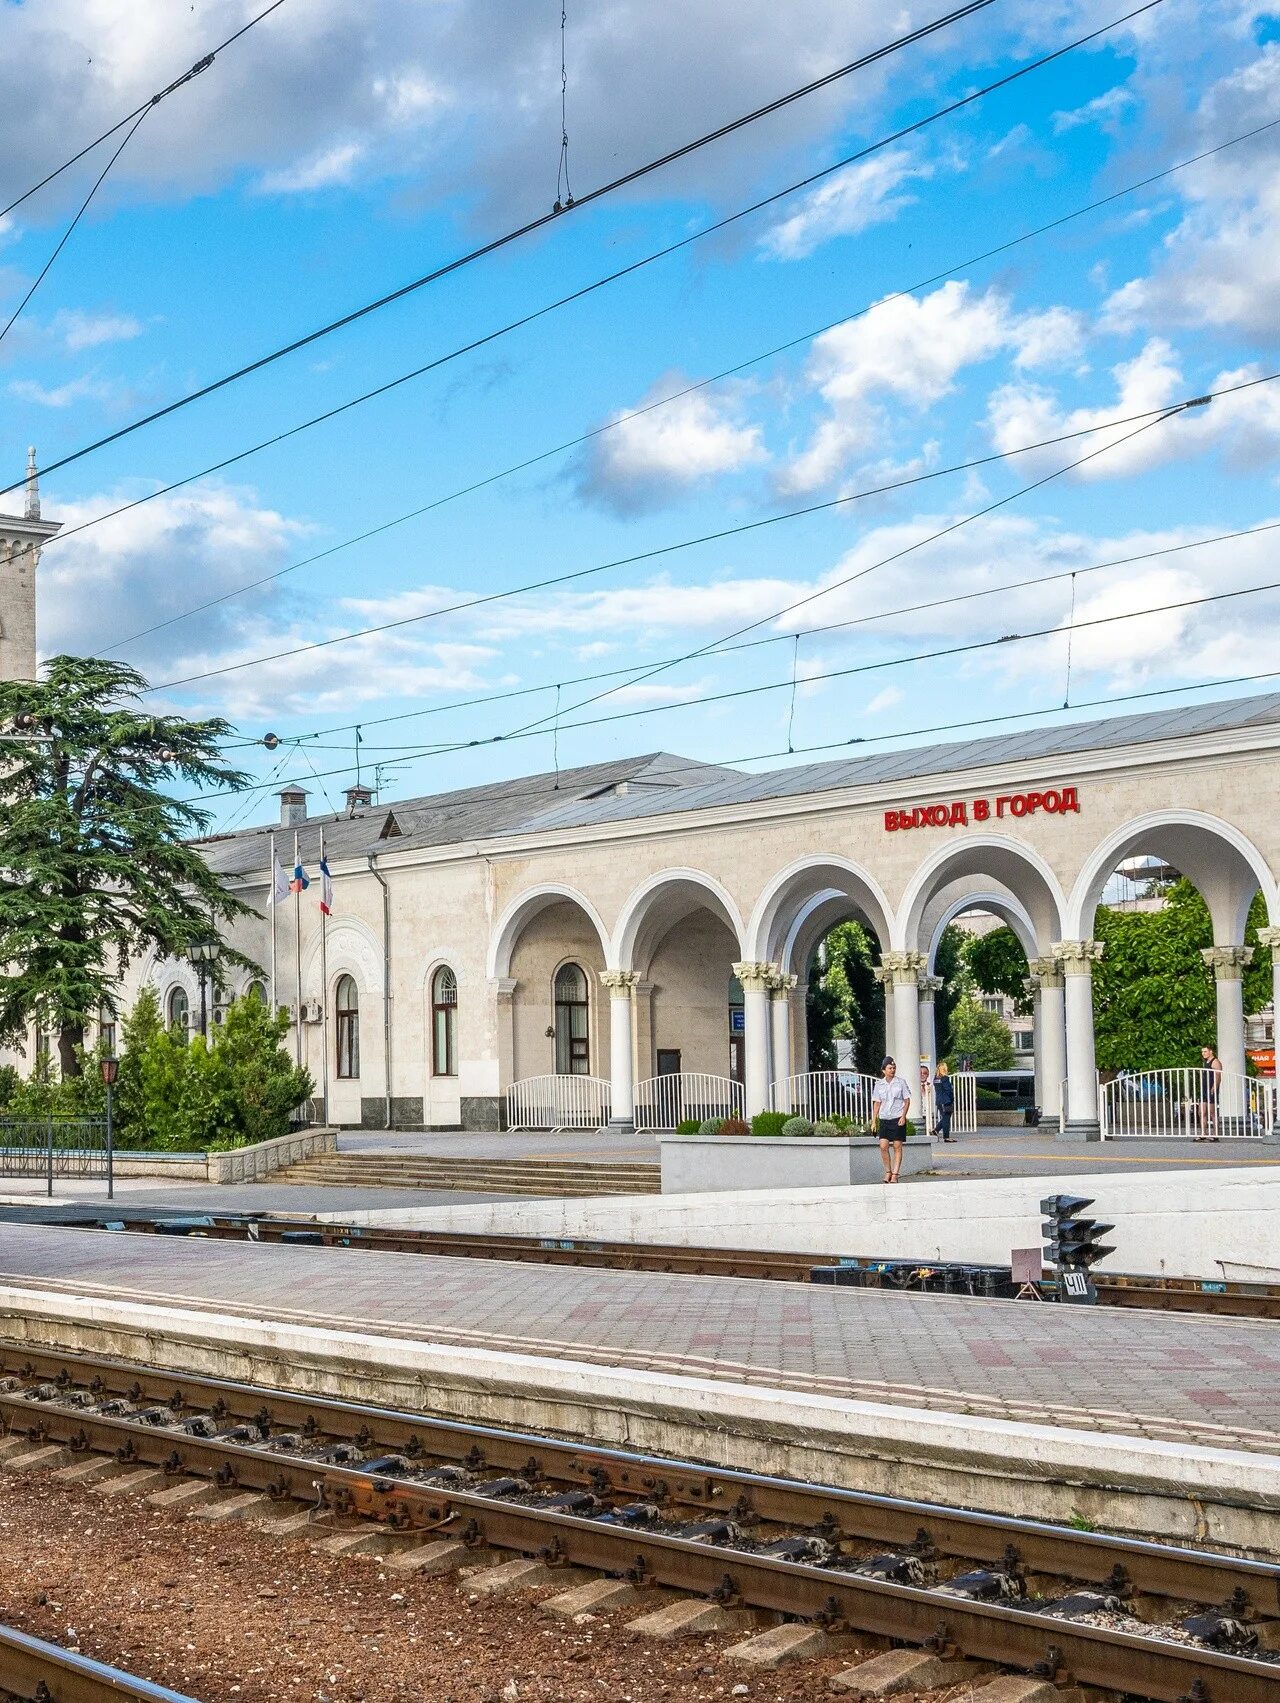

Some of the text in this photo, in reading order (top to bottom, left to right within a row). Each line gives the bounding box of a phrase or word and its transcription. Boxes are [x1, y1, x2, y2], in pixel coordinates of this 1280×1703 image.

[884, 787, 1081, 832] ВЫХОД В ГОРОД
